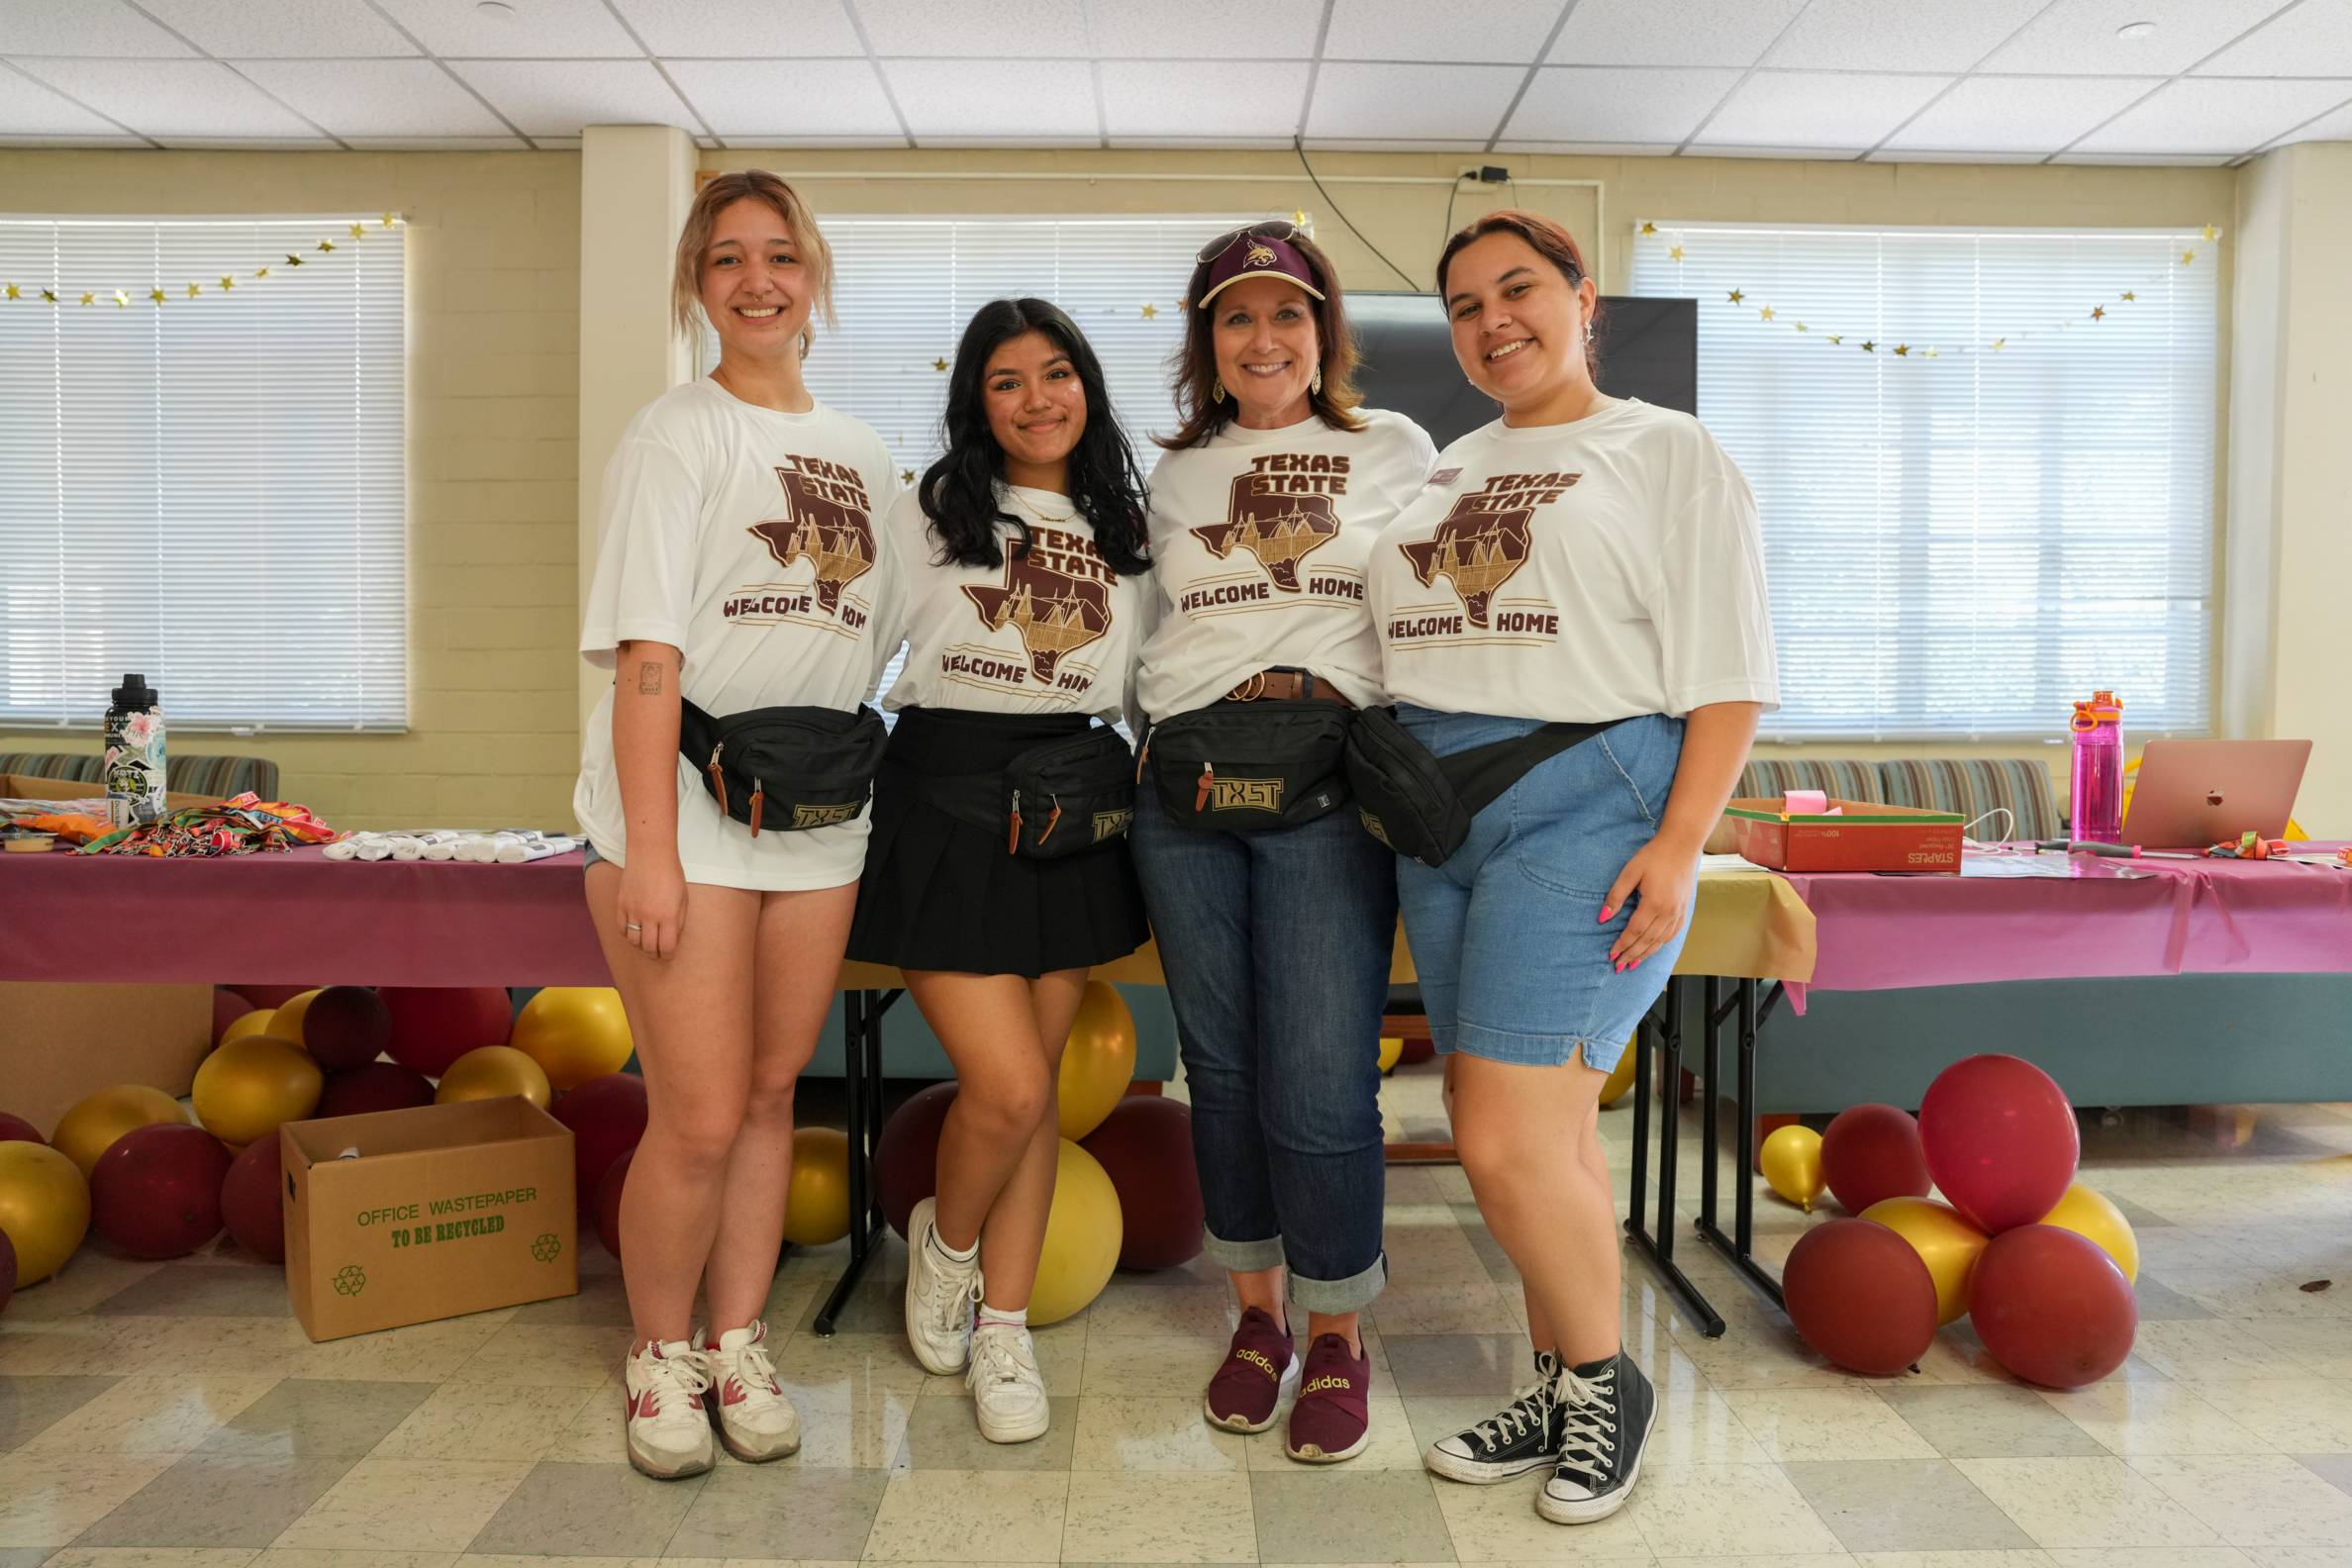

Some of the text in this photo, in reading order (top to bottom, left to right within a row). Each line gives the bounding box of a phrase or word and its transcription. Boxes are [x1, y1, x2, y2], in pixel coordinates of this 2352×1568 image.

[784, 453, 865, 490] TEXAS
[1251, 453, 1350, 474] TEXAS
[799, 475, 872, 514] STATE
[1251, 474, 1347, 496] STATE
[1485, 472, 1584, 494] TEXAS
[1467, 489, 1567, 515] STATE
[1029, 526, 1104, 562] TEXA
[1029, 548, 1119, 587] STATE
[1180, 577, 1364, 613] WELCOME HOME
[1496, 612, 1560, 636] HOME
[1213, 777, 1284, 813] TXST
[1908, 851, 1955, 864] STAPLES
[357, 1187, 538, 1227] OFFICE WASTEPAPER
[391, 1215, 505, 1248] TO BE RECYCLED
[1235, 1348, 1279, 1383] adidas
[1299, 1375, 1351, 1399] adidas
